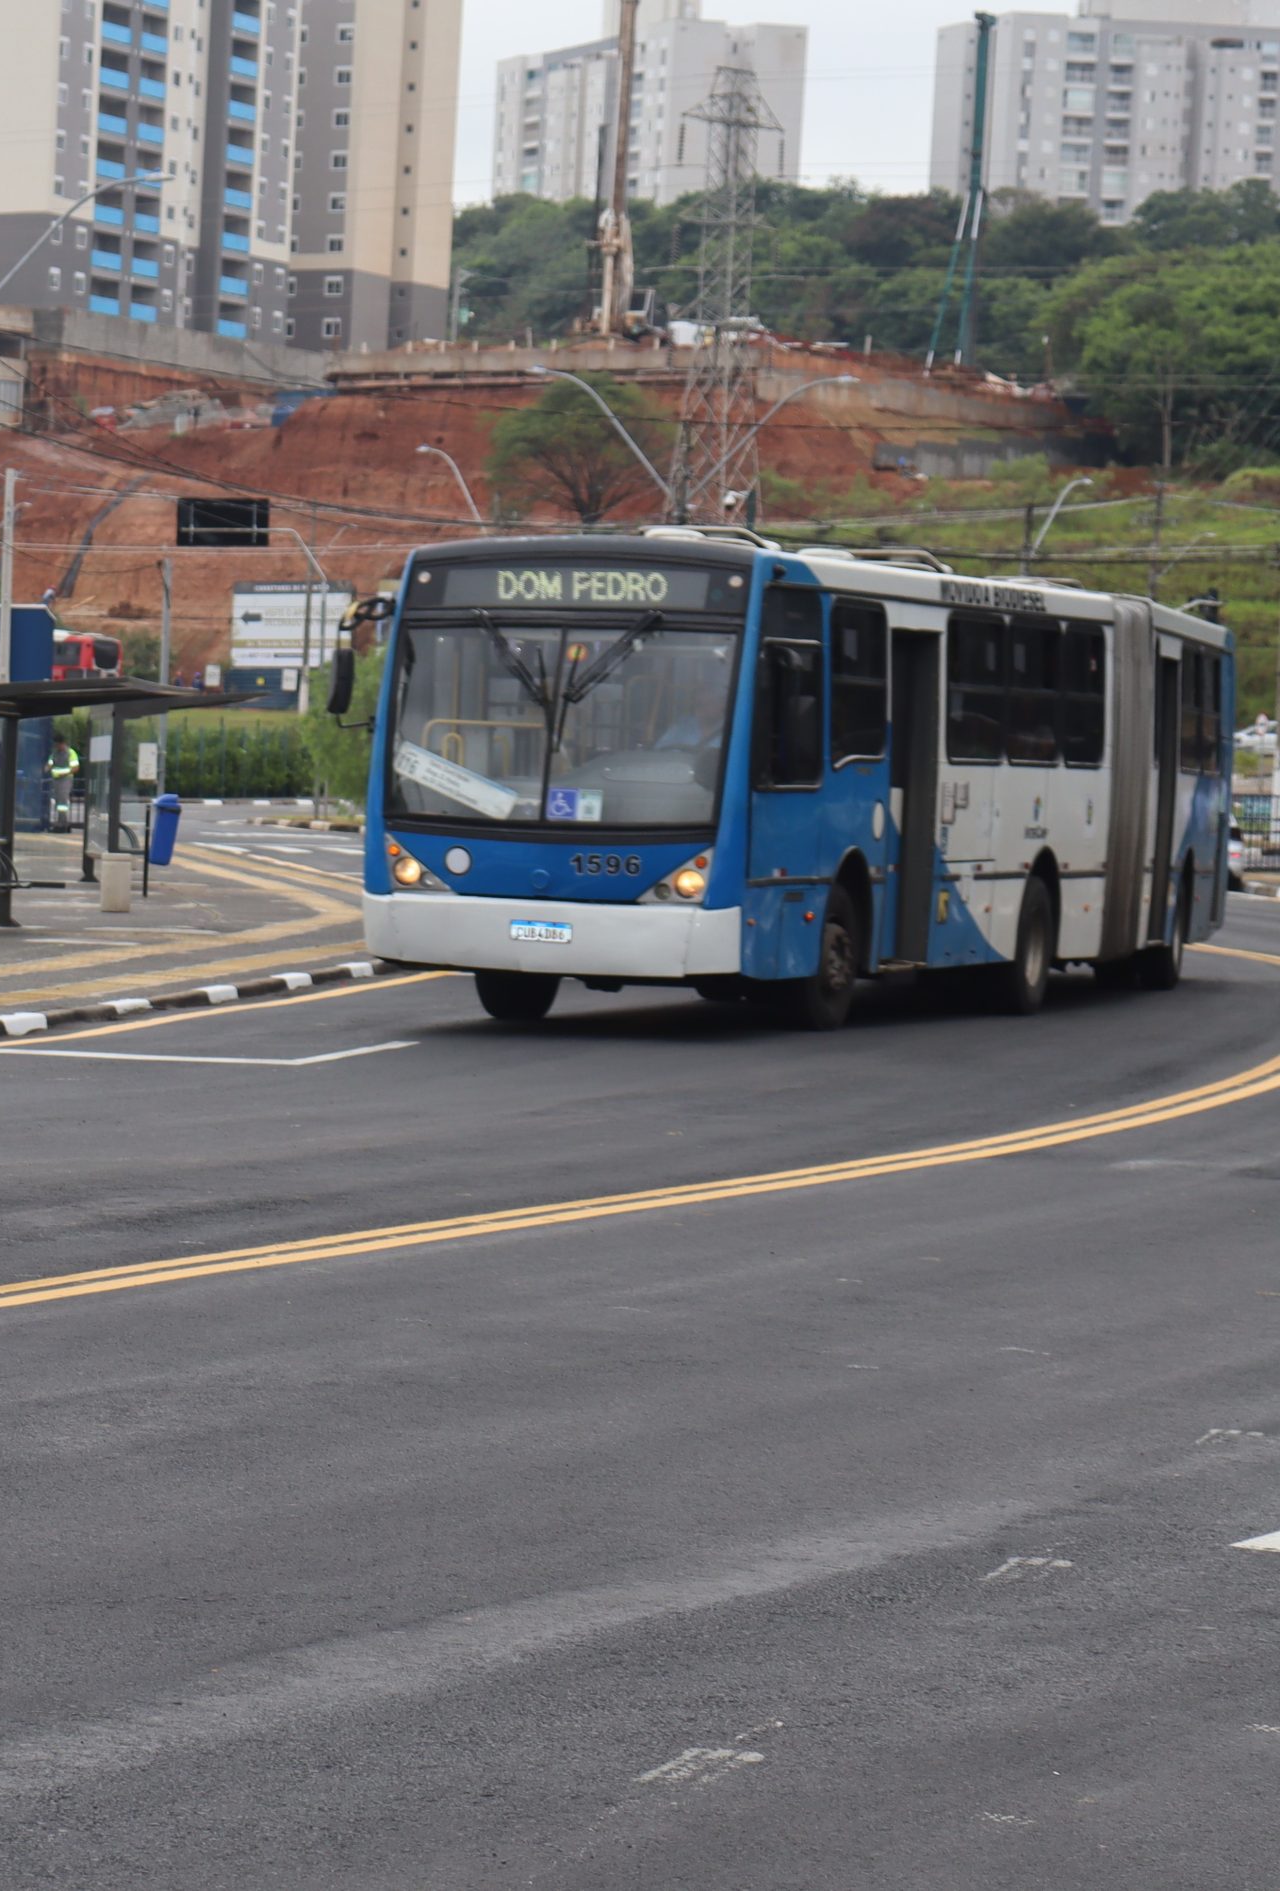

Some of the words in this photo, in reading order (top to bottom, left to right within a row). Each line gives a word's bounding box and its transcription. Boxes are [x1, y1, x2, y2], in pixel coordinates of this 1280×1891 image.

[498, 570, 562, 600] DOM
[573, 571, 668, 601] PEDRO
[570, 853, 641, 876] 1596
